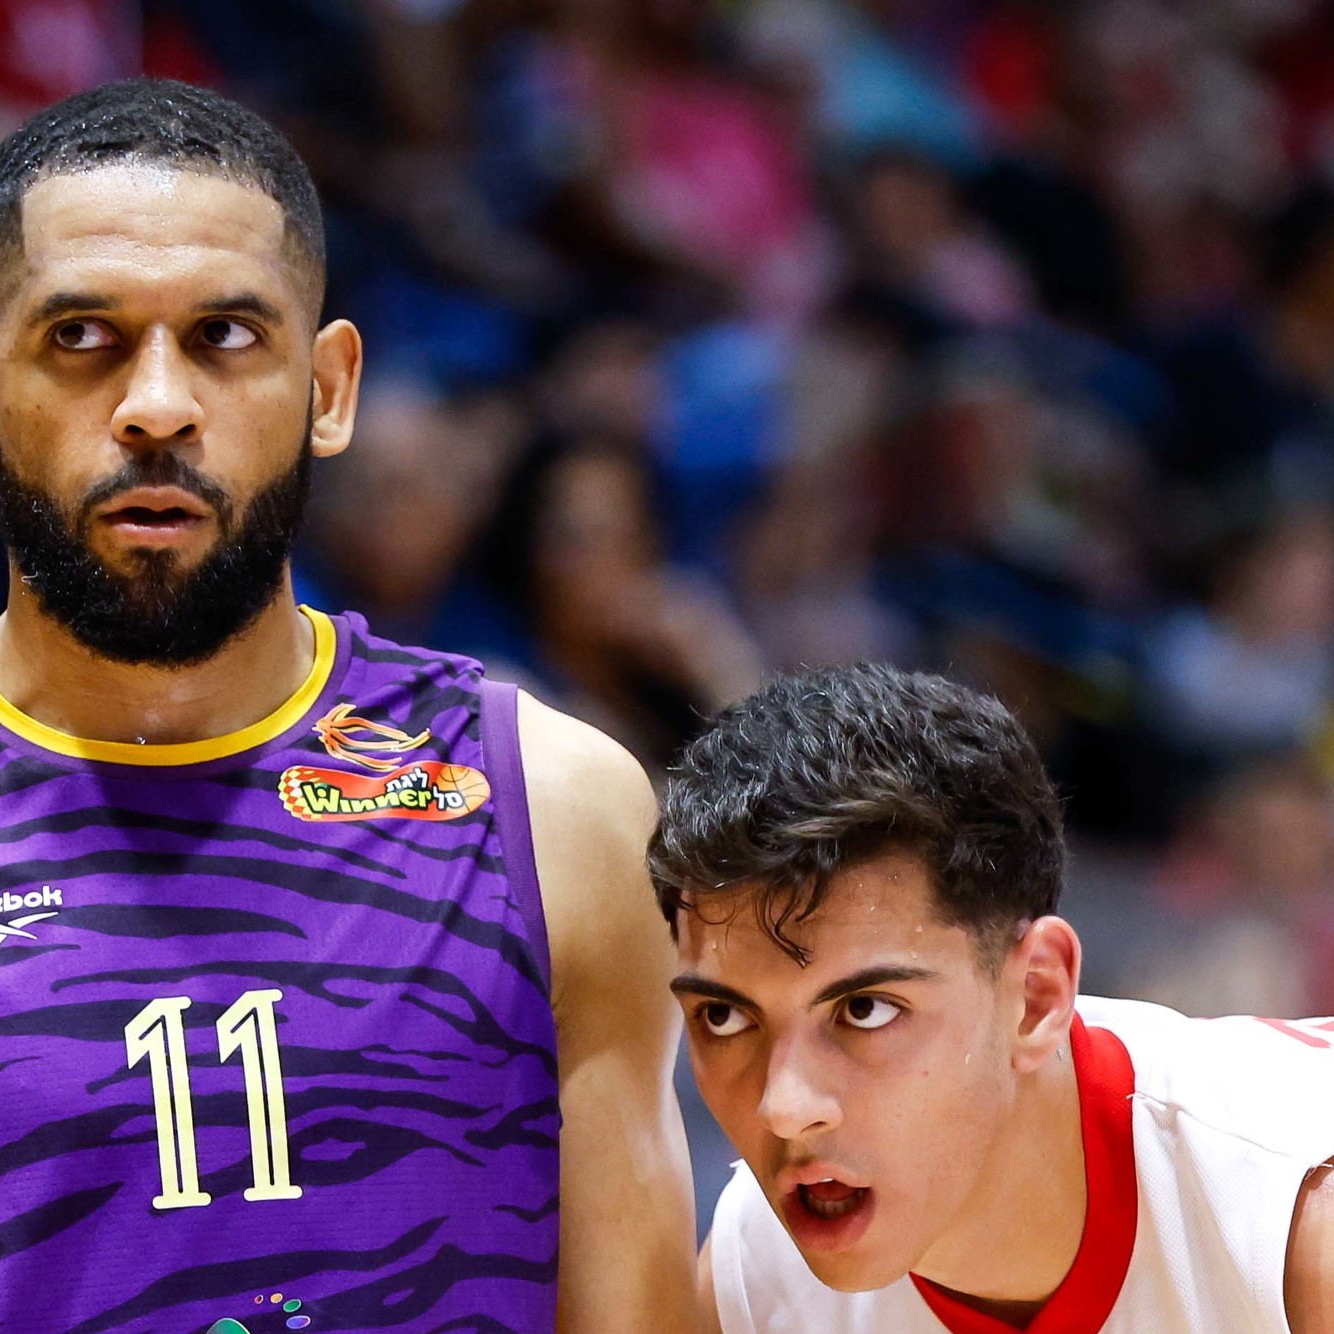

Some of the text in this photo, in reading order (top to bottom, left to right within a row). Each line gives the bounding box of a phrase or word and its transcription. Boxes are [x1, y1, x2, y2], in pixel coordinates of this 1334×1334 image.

[386, 767, 428, 792] ליגת
[302, 784, 432, 813] Winner
[433, 786, 463, 810] סל
[124, 988, 303, 1210] 11
